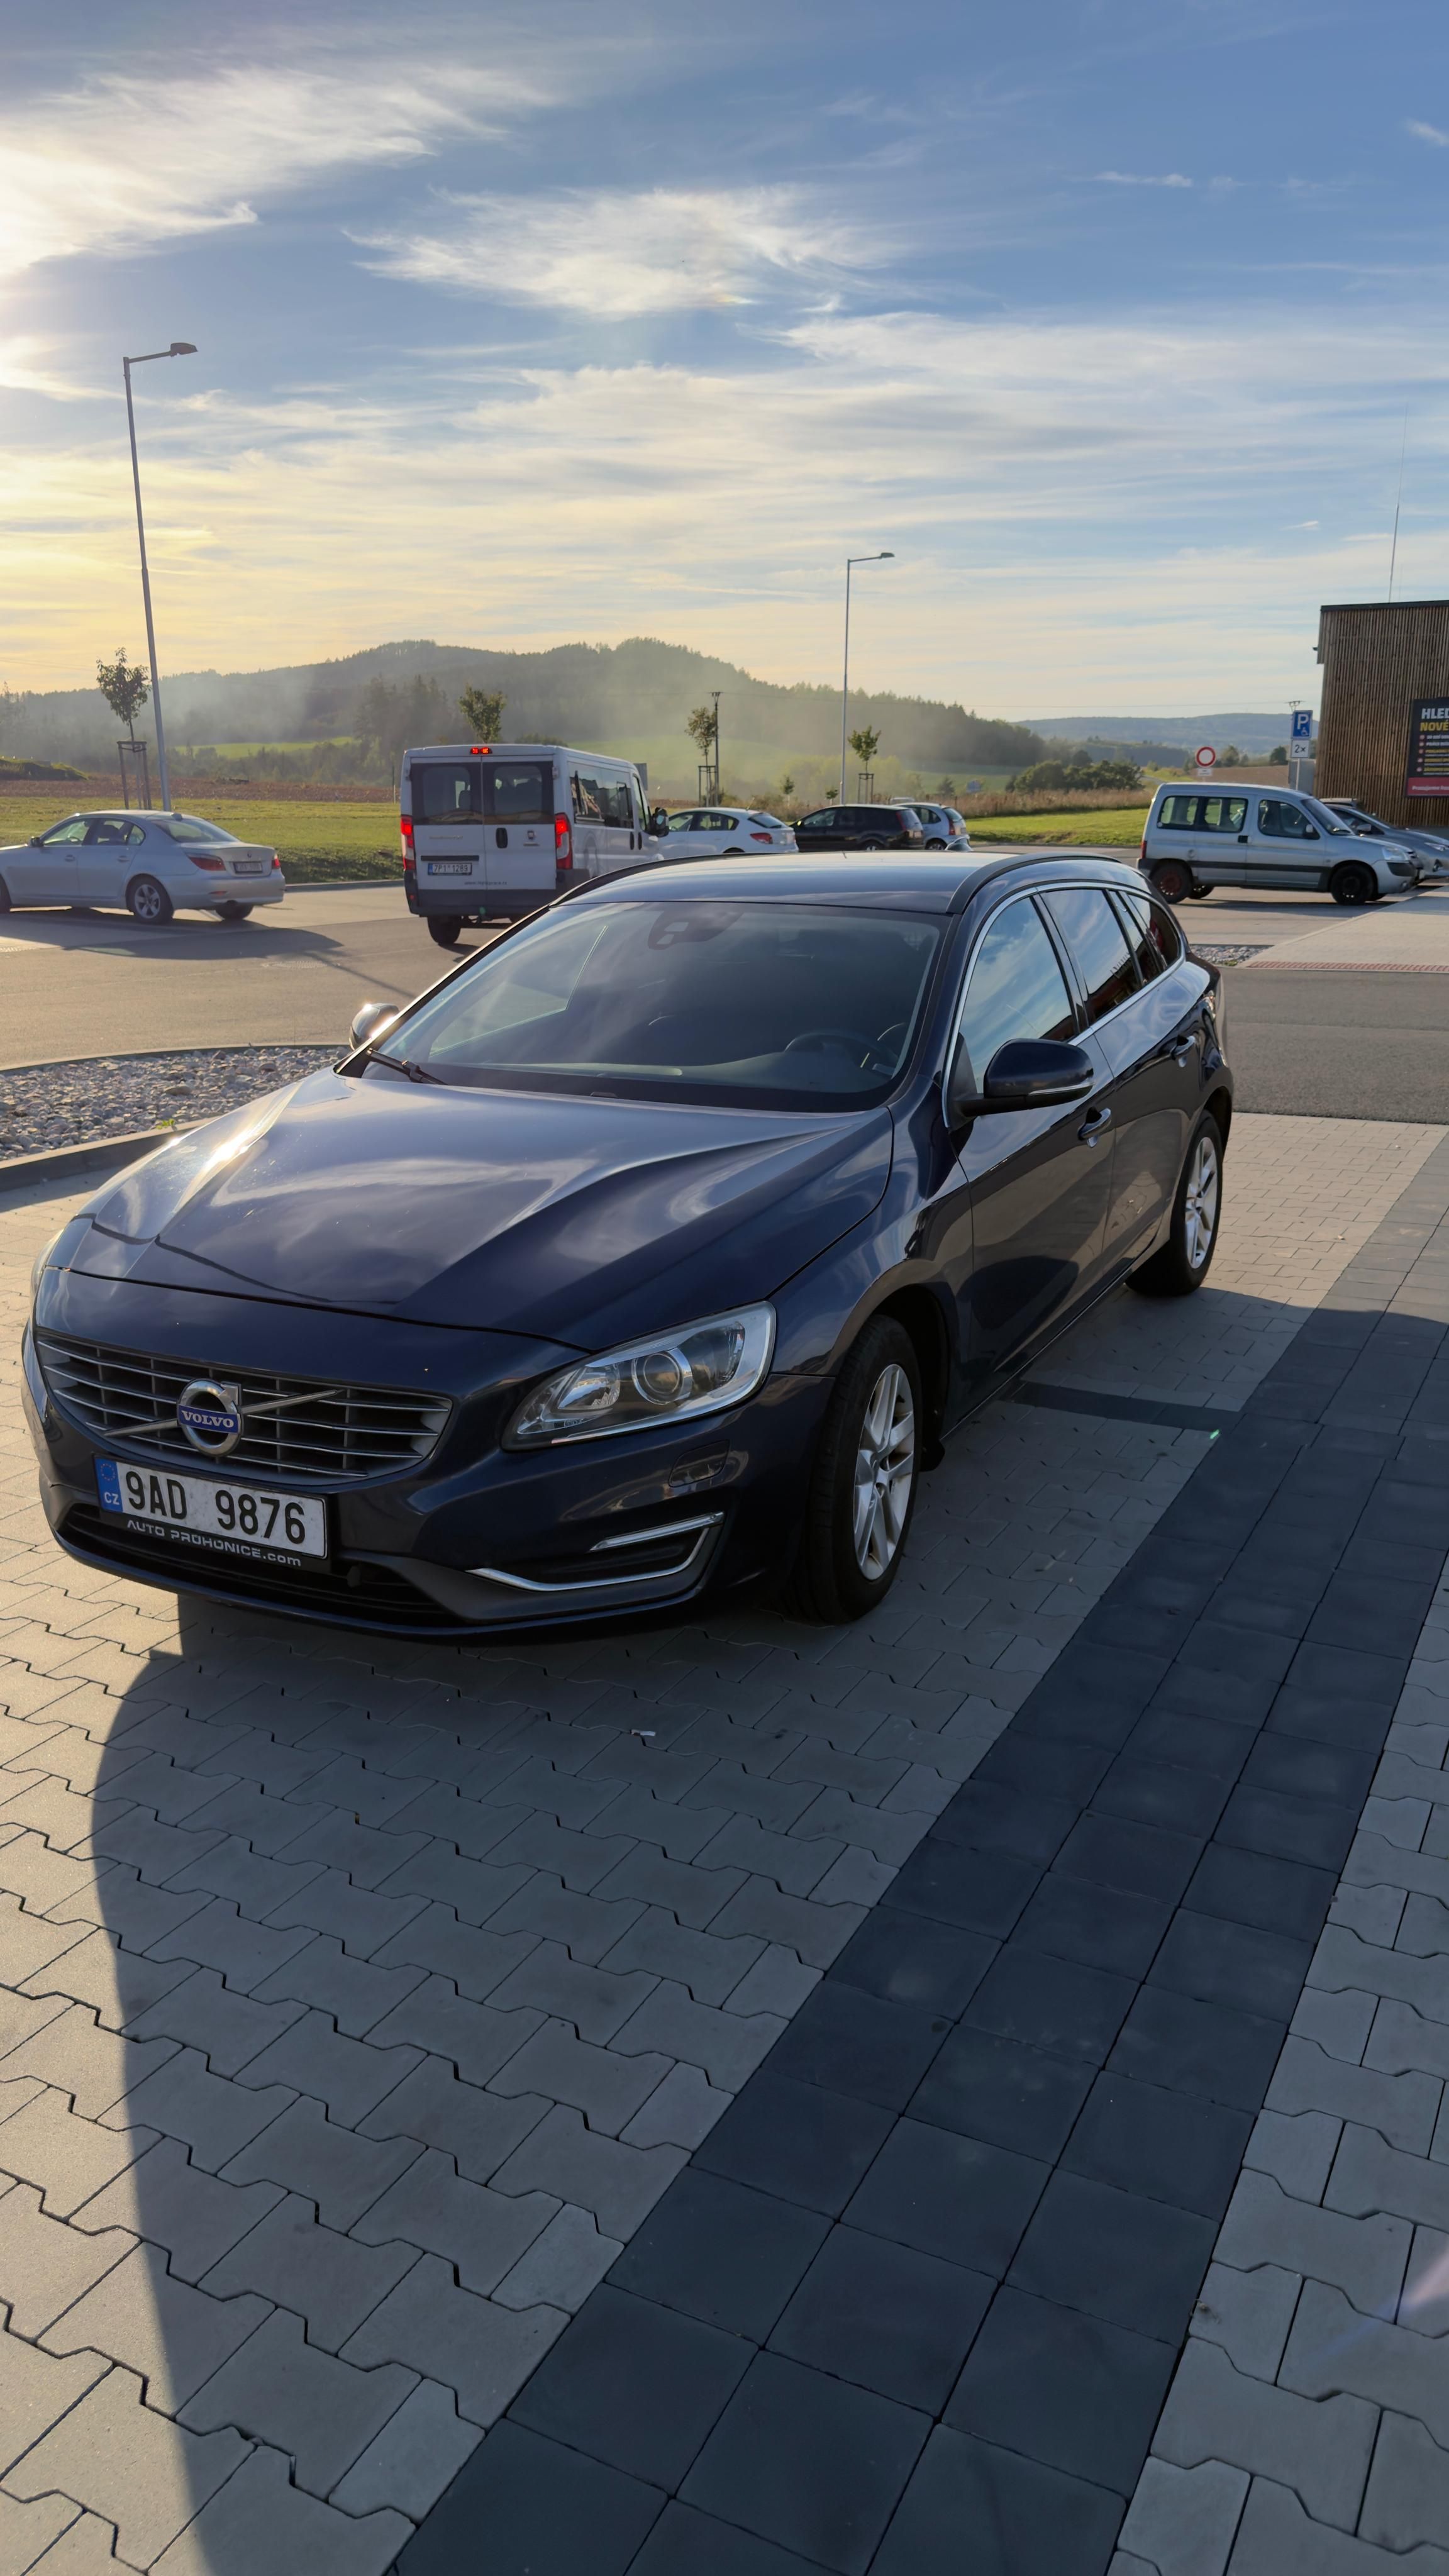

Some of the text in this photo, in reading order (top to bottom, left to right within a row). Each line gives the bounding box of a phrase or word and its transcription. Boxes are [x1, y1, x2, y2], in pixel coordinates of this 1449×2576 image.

[1297, 714, 1309, 730] P
[1294, 744, 1306, 753] 2x
[181, 1410, 234, 1428] VOLVO
[104, 1491, 119, 1505] CZ
[126, 1470, 305, 1545] 9AD 9876
[127, 1519, 165, 1536] AUTO
